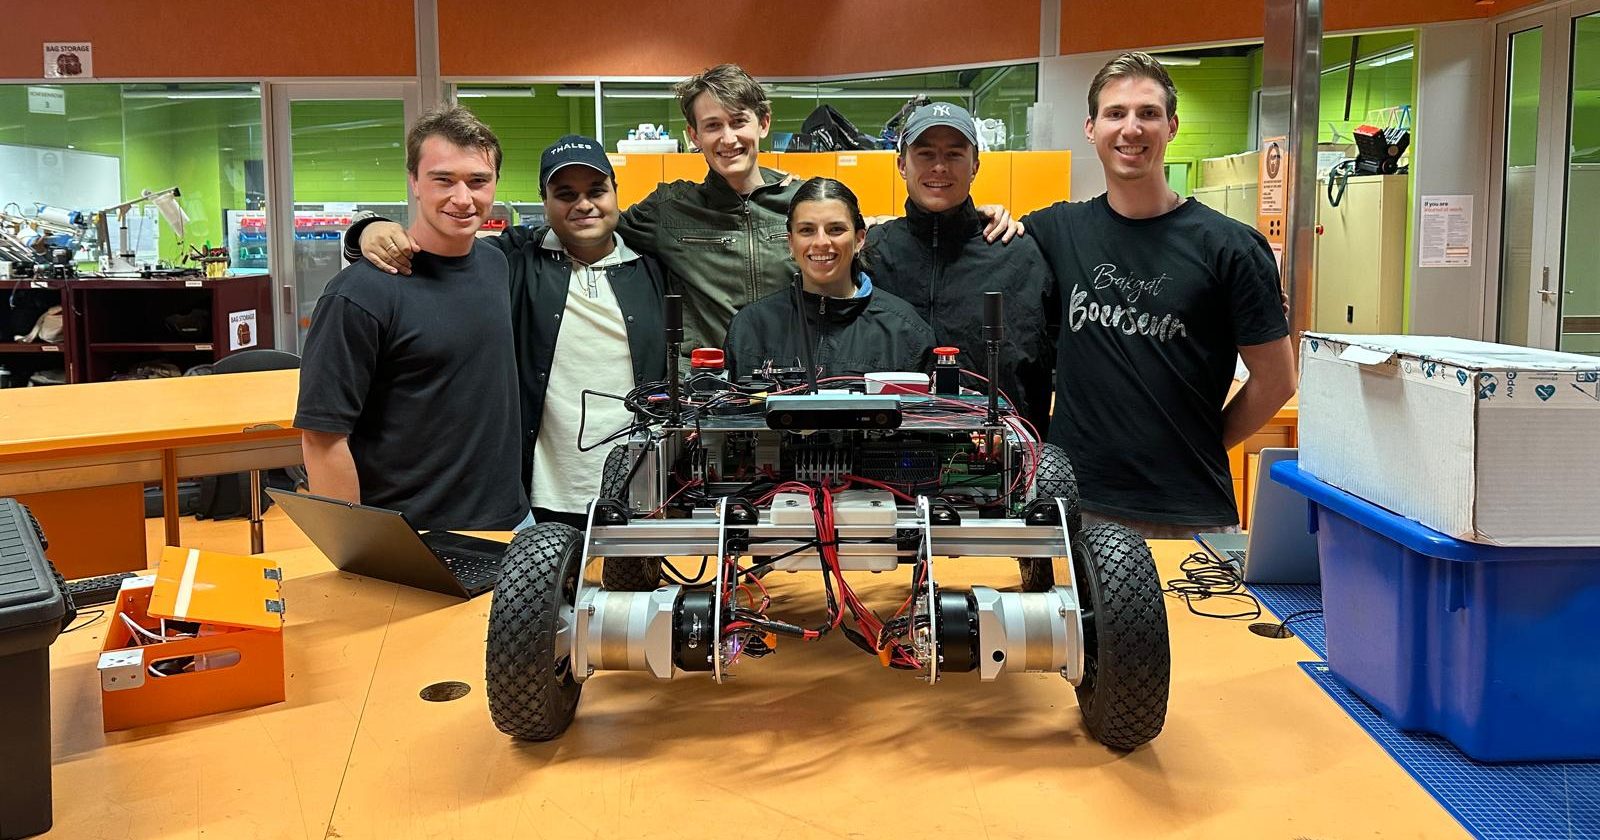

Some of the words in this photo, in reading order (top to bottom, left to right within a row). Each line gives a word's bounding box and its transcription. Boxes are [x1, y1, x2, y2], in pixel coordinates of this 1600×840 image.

[550, 142, 592, 155] THALES
[1093, 263, 1173, 303] Bakgat
[239, 313, 255, 321] STORAGE
